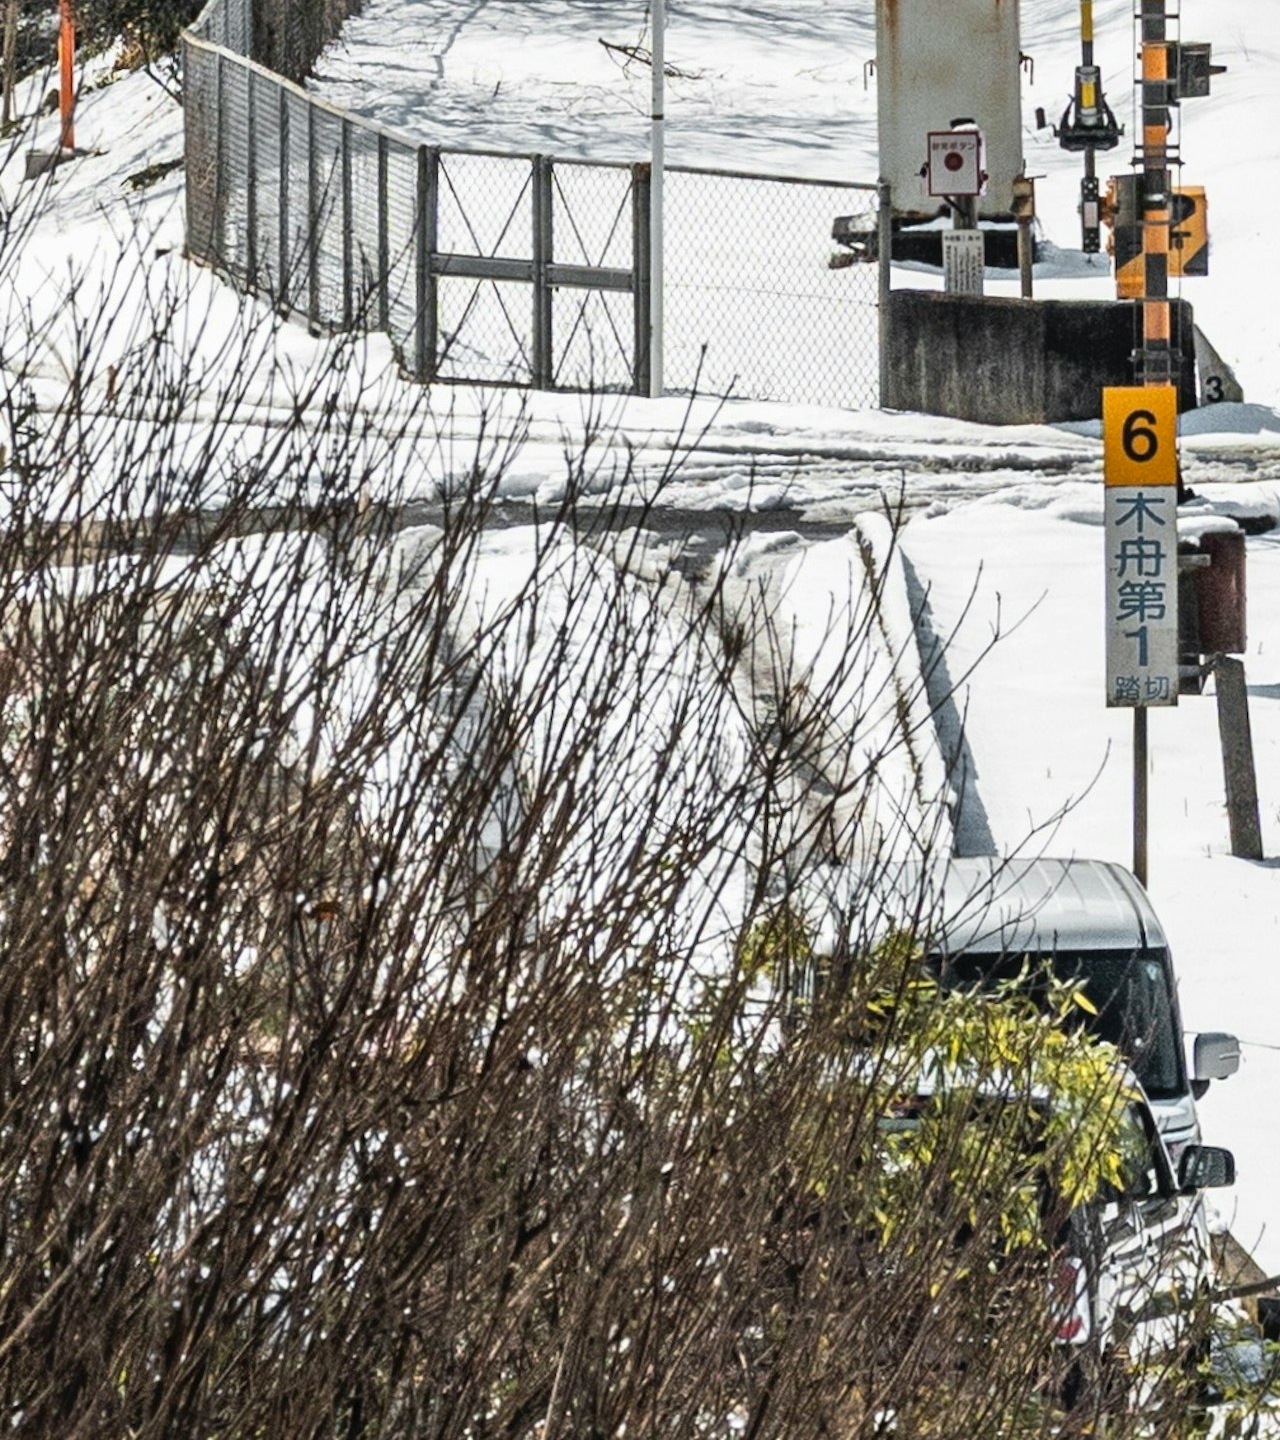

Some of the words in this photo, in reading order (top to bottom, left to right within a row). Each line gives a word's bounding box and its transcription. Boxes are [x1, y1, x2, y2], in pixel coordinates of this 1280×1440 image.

[1206, 376, 1224, 403] 3
[1122, 409, 1158, 462] 6
[1115, 492, 1166, 667] 木舟第1
[1115, 676, 1169, 701] 踏切
